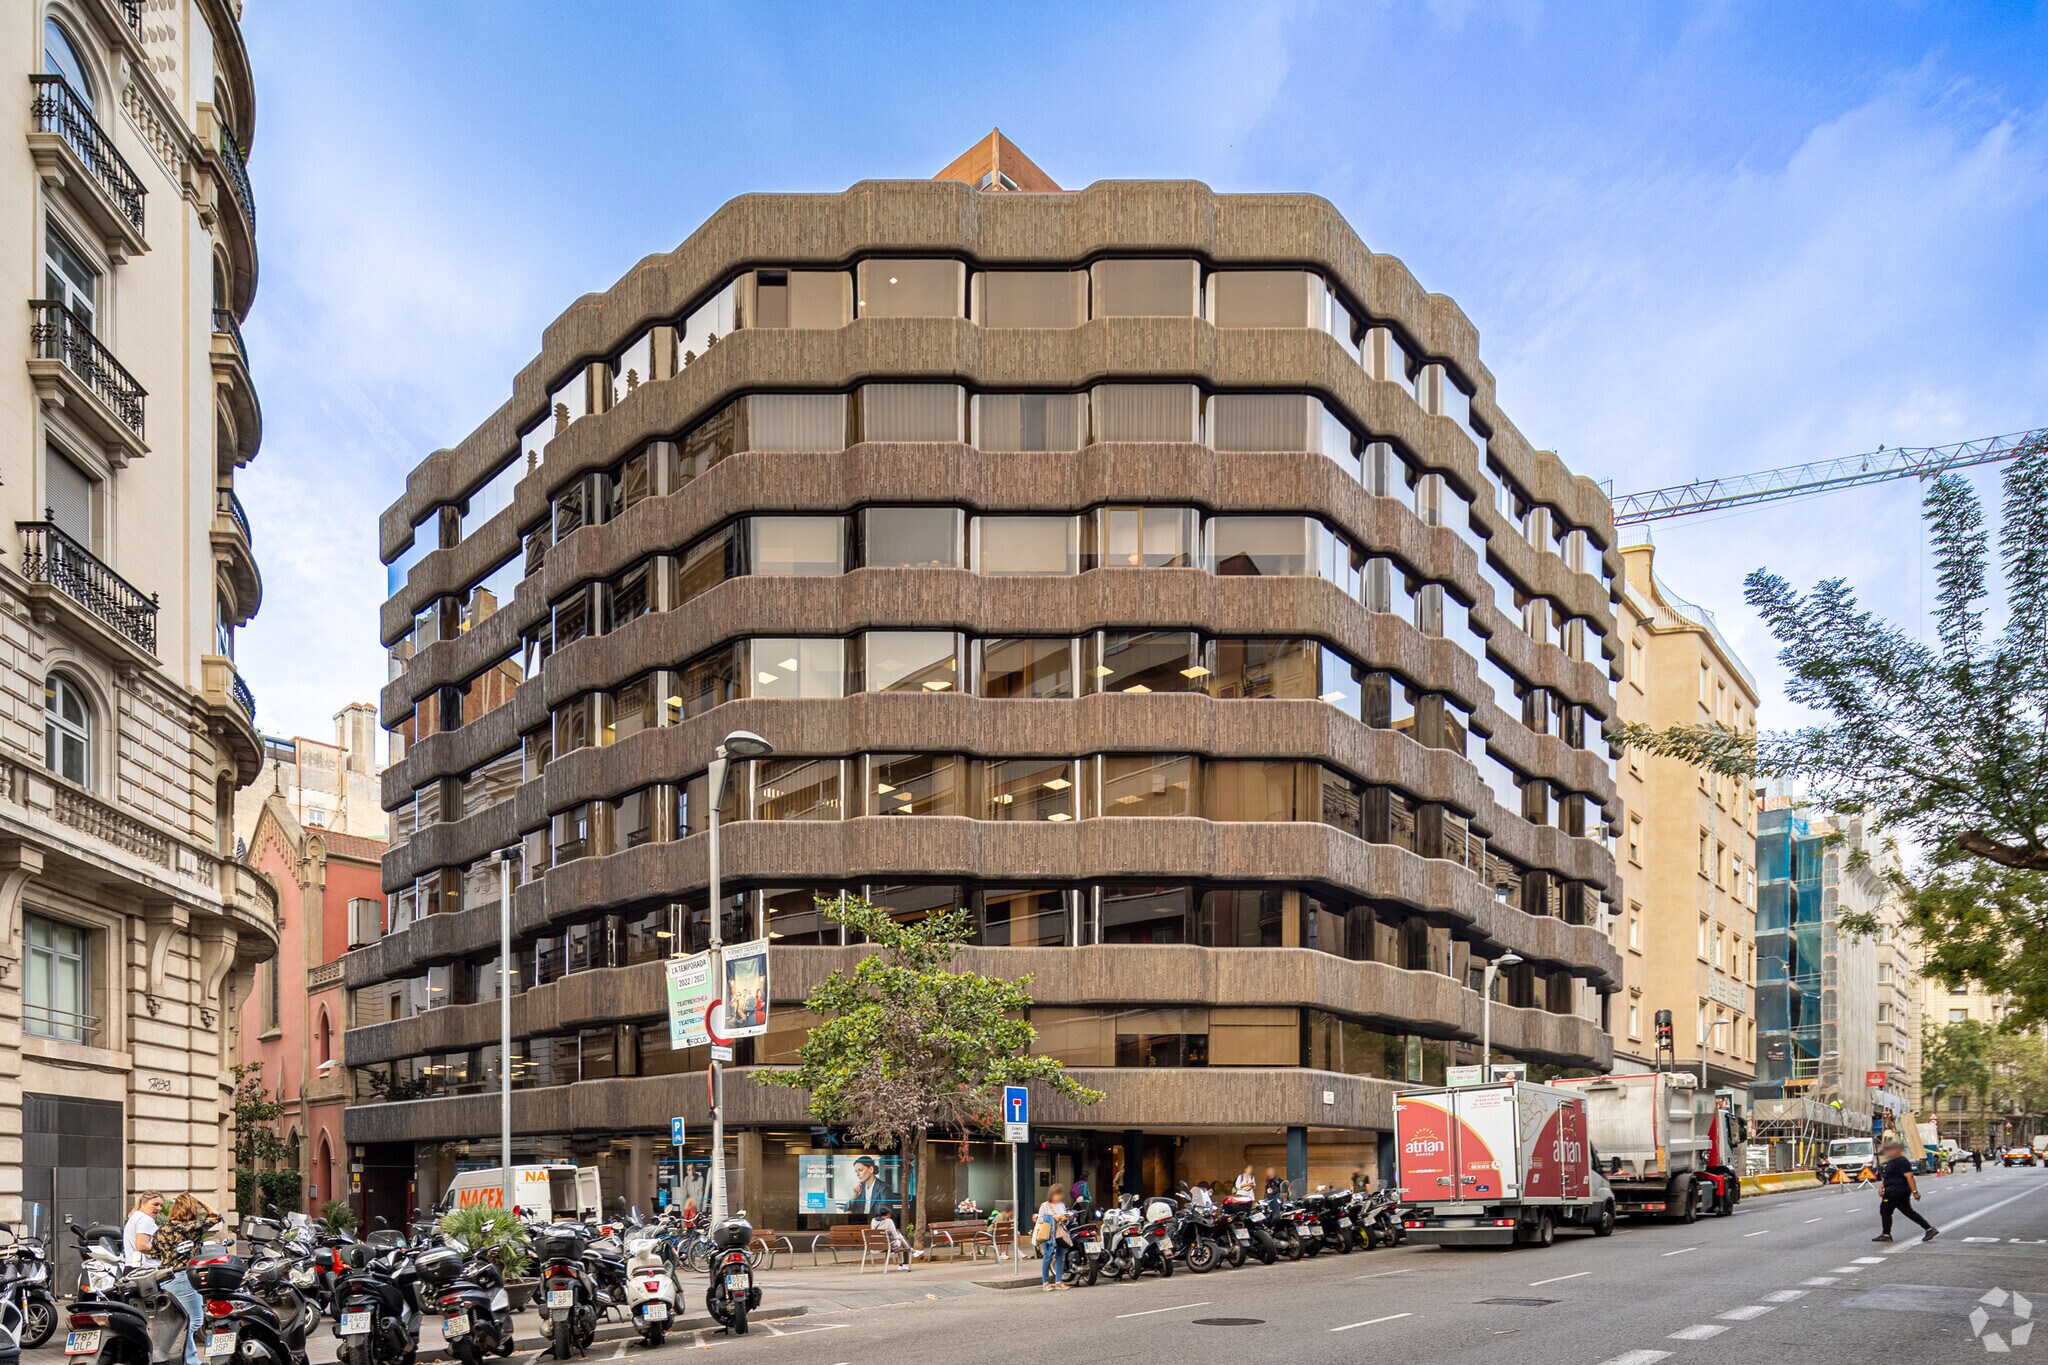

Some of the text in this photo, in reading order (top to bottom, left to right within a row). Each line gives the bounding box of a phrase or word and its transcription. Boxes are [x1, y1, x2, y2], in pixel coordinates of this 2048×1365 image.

[678, 959, 706, 973] TEMPORADA
[679, 978, 690, 987] 2022
[694, 974, 705, 983] 2023
[676, 995, 708, 1007] TEATREROMEA
[677, 1005, 705, 1016] TEATREGOYA
[691, 1035, 707, 1044] FOCUS
[674, 1122, 680, 1132] P
[1039, 1134, 1068, 1145] CaixaBank
[1405, 1140, 1444, 1154] atrian
[460, 1188, 503, 1210] NACEX
[348, 1313, 369, 1323] 2469
[449, 1316, 467, 1327] 2876
[351, 1321, 367, 1330] LKJ
[75, 1331, 99, 1342] 7875
[73, 1341, 92, 1351] DLP
[213, 1342, 228, 1352] JSP
